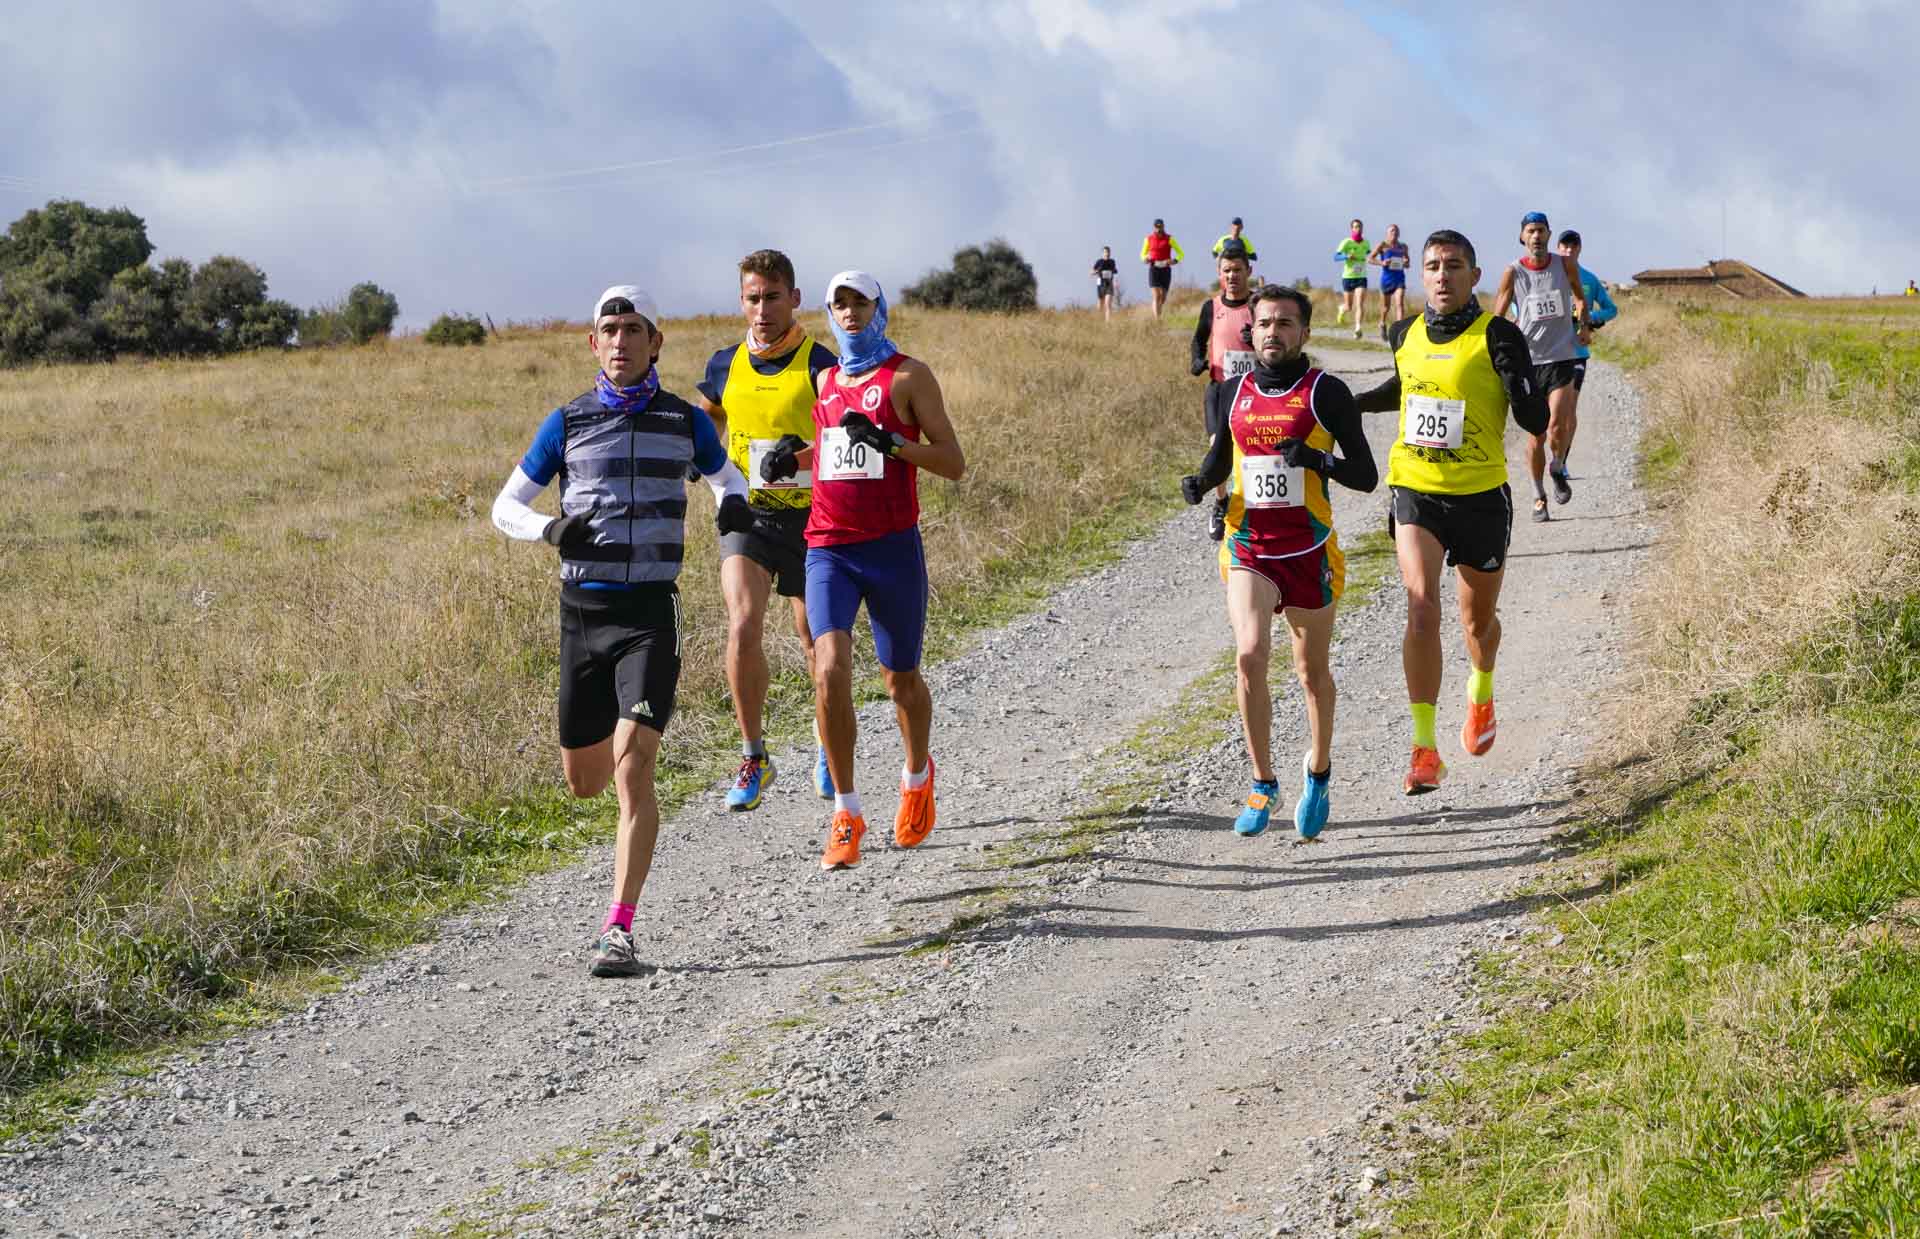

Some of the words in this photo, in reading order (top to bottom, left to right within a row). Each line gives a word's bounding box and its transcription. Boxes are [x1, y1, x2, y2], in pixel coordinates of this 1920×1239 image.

[1537, 301, 1556, 315] 315
[1231, 360, 1252, 374] 300
[1254, 425, 1282, 435] VINO
[1416, 413, 1448, 439] 295
[1246, 436, 1260, 446] DE
[833, 443, 866, 469] 340
[1255, 473, 1288, 498] 358
